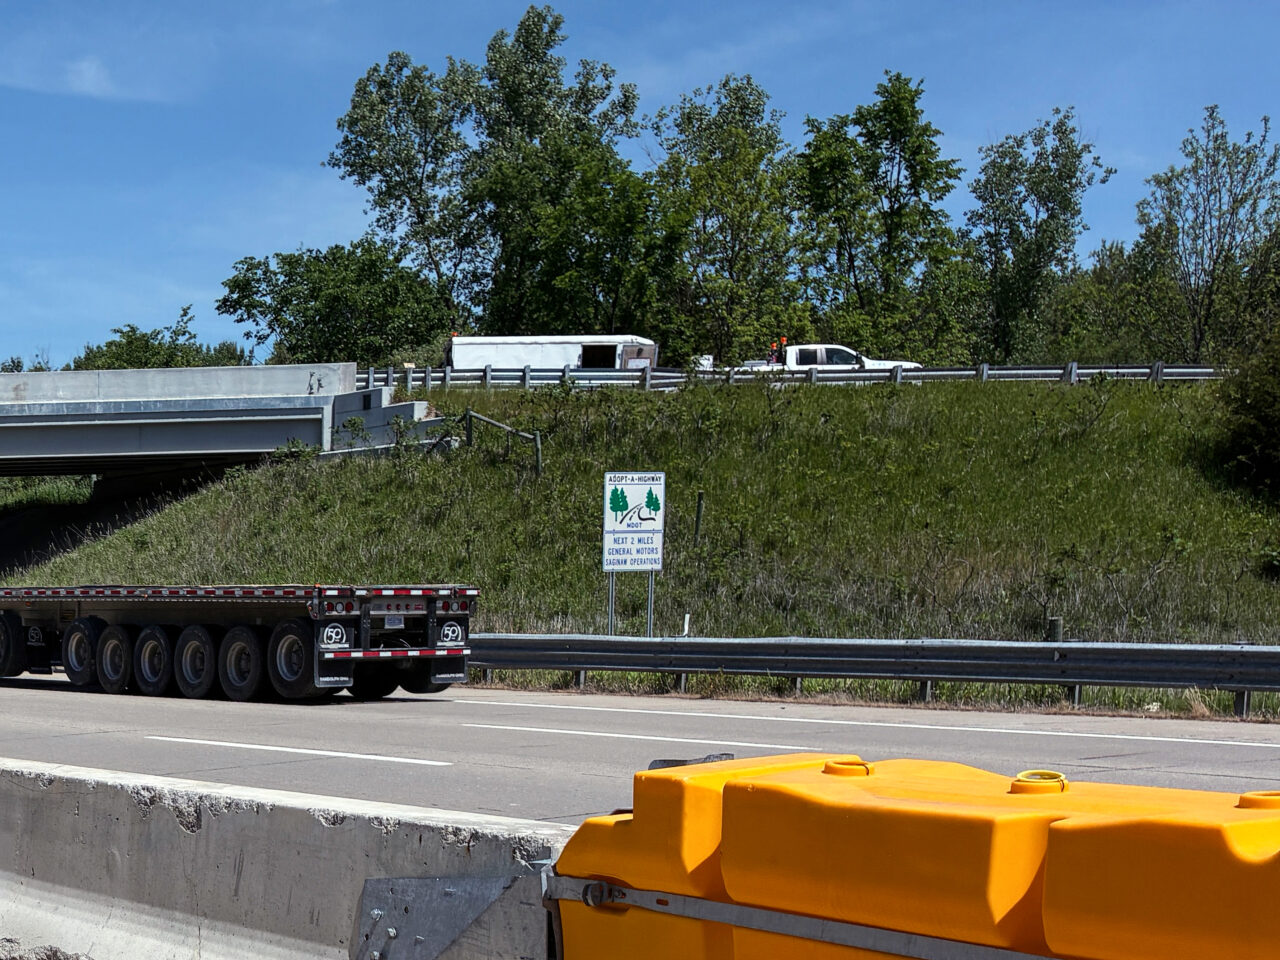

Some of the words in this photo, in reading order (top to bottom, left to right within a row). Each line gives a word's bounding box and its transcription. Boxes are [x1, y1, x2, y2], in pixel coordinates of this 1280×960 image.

[608, 475, 662, 483] ADOPT-A-HIGHWAY
[613, 537, 628, 545] NEXT
[630, 537, 635, 545] 2
[637, 536, 654, 545] MILES
[607, 548, 633, 556] GENERAL
[635, 547, 659, 555] MOTORS
[605, 558, 628, 566] SAGINAW
[629, 558, 660, 566] OPERATIONS
